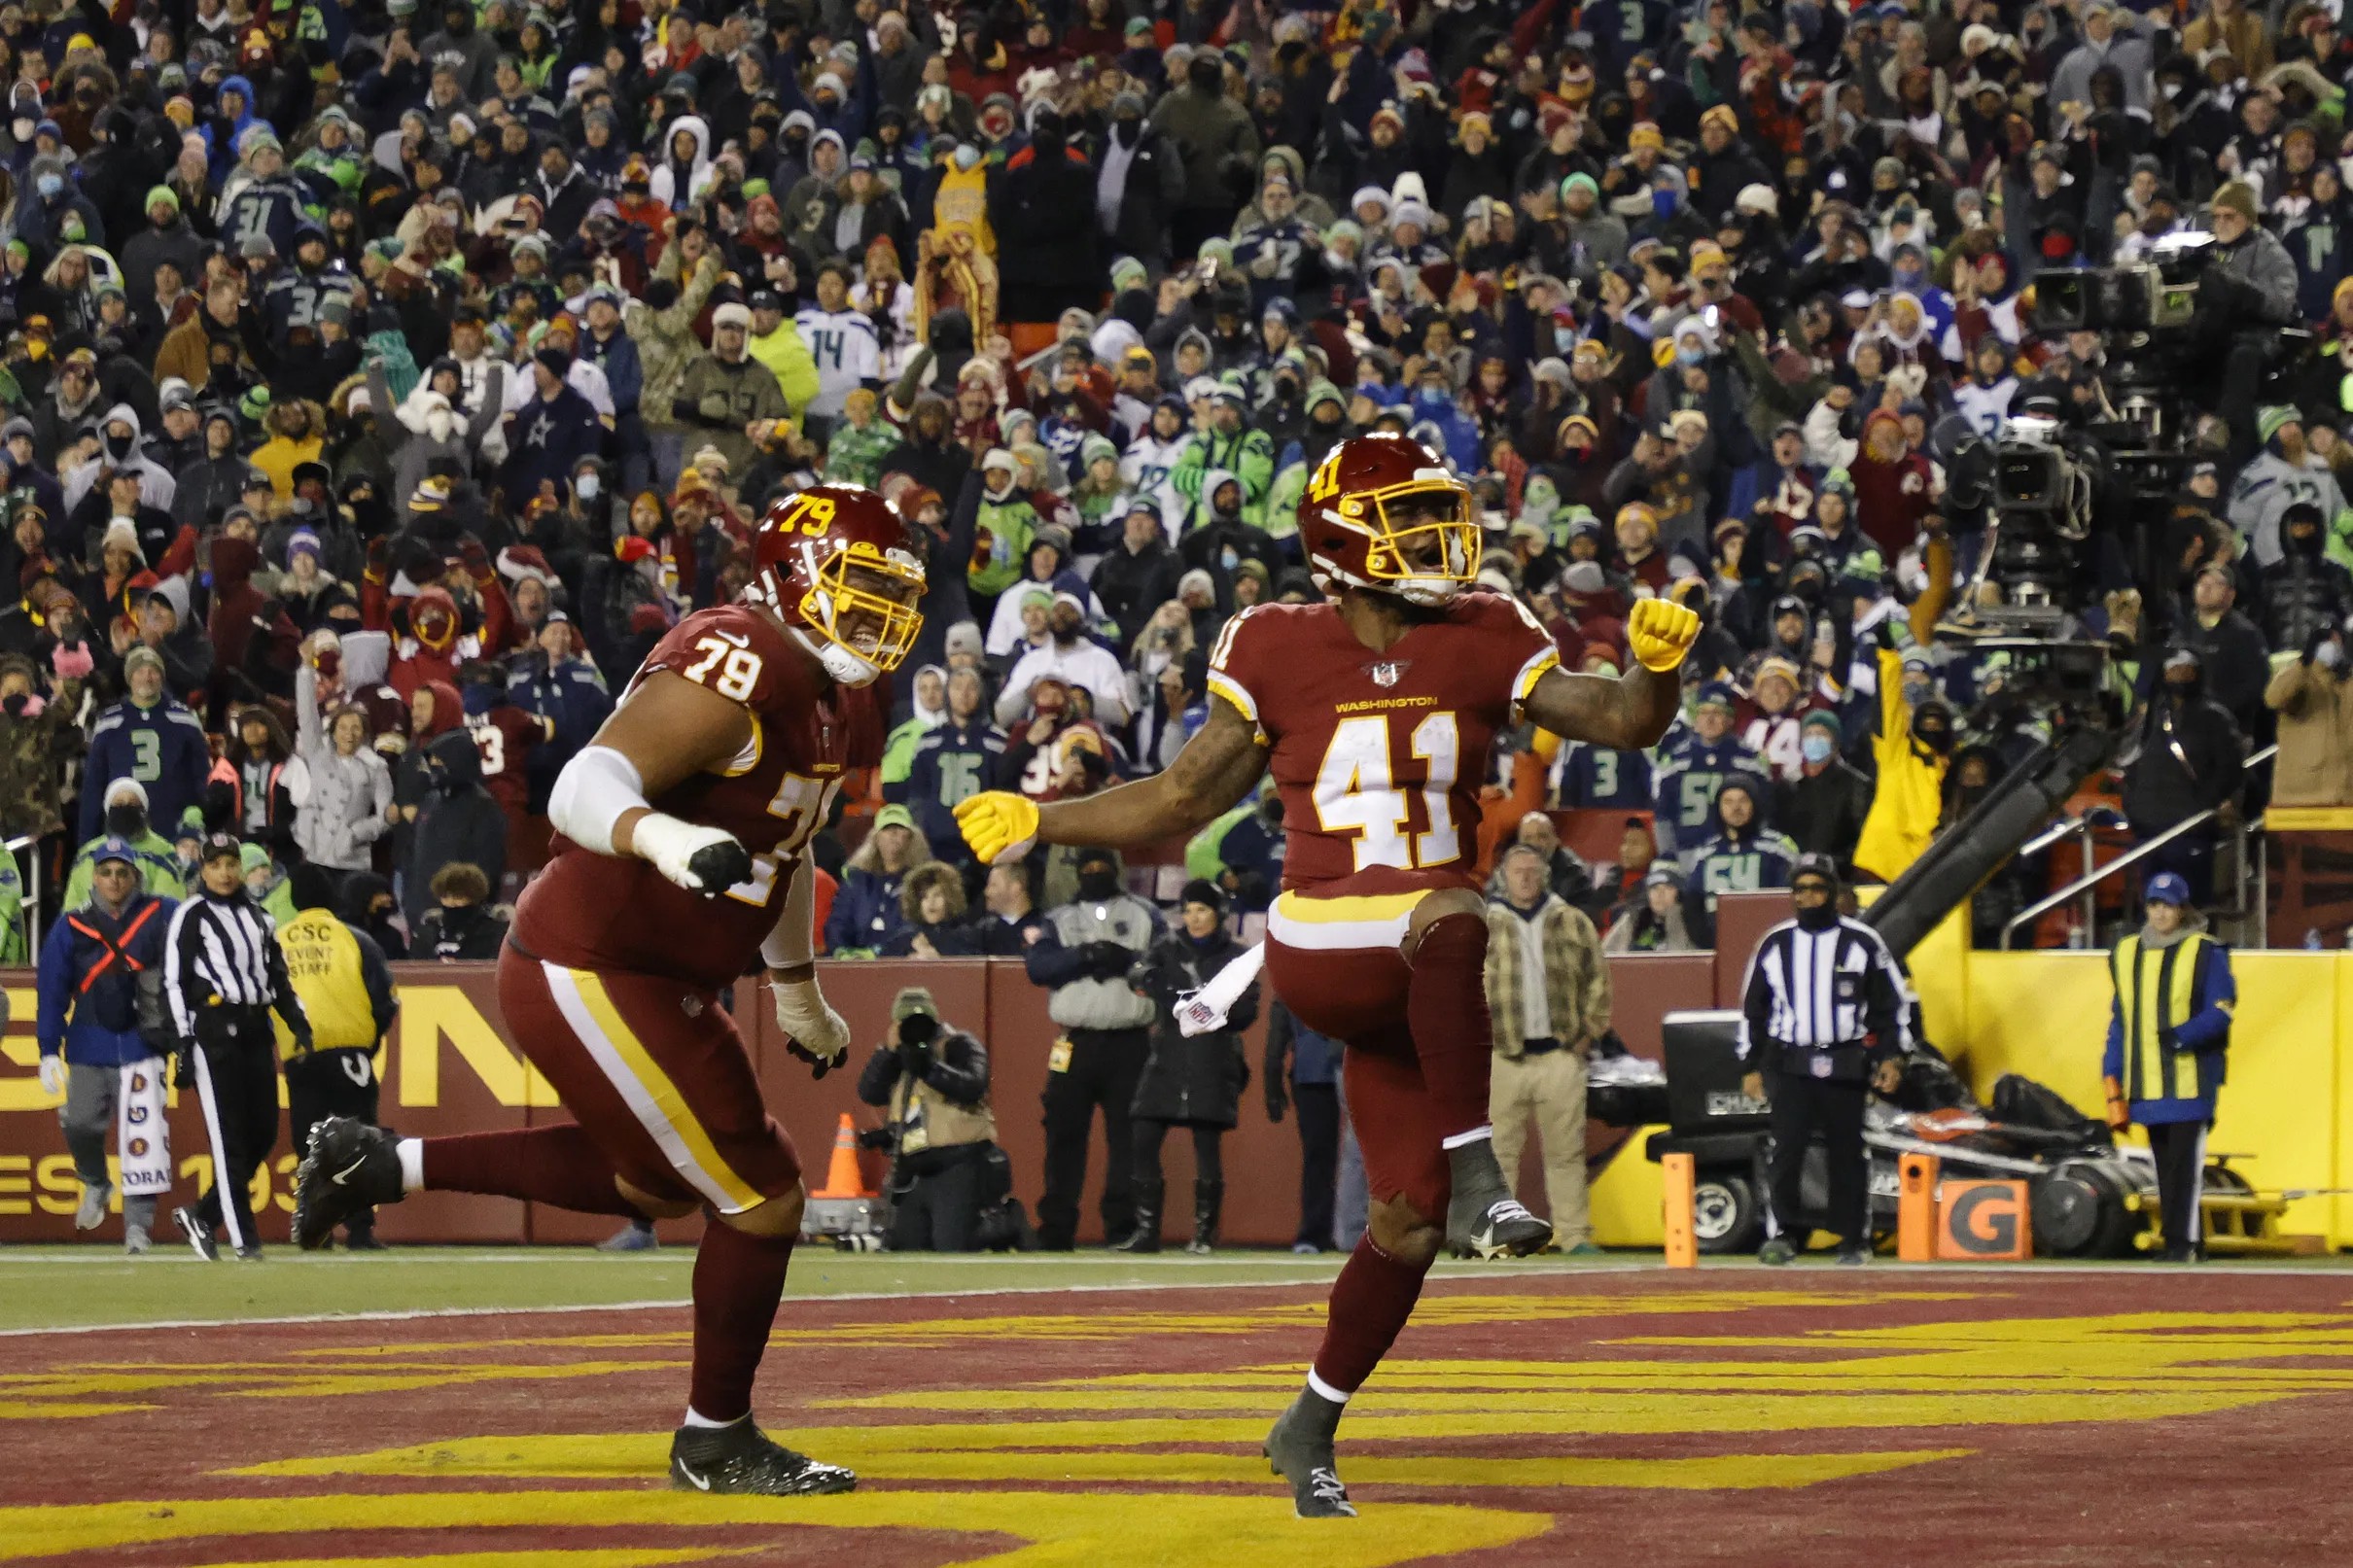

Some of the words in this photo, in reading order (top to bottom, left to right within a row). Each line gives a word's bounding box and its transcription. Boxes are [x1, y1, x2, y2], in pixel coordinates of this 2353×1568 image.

[1618, 2, 1644, 41] 3
[813, 329, 844, 370] 14
[779, 493, 835, 538] 79
[683, 637, 763, 702] 79
[1335, 696, 1438, 714] WASHINGTON
[131, 729, 160, 782] 3
[1593, 750, 1618, 798] 3
[1312, 711, 1461, 873] 41
[287, 922, 332, 943] CSC
[1949, 1184, 2017, 1253] G
